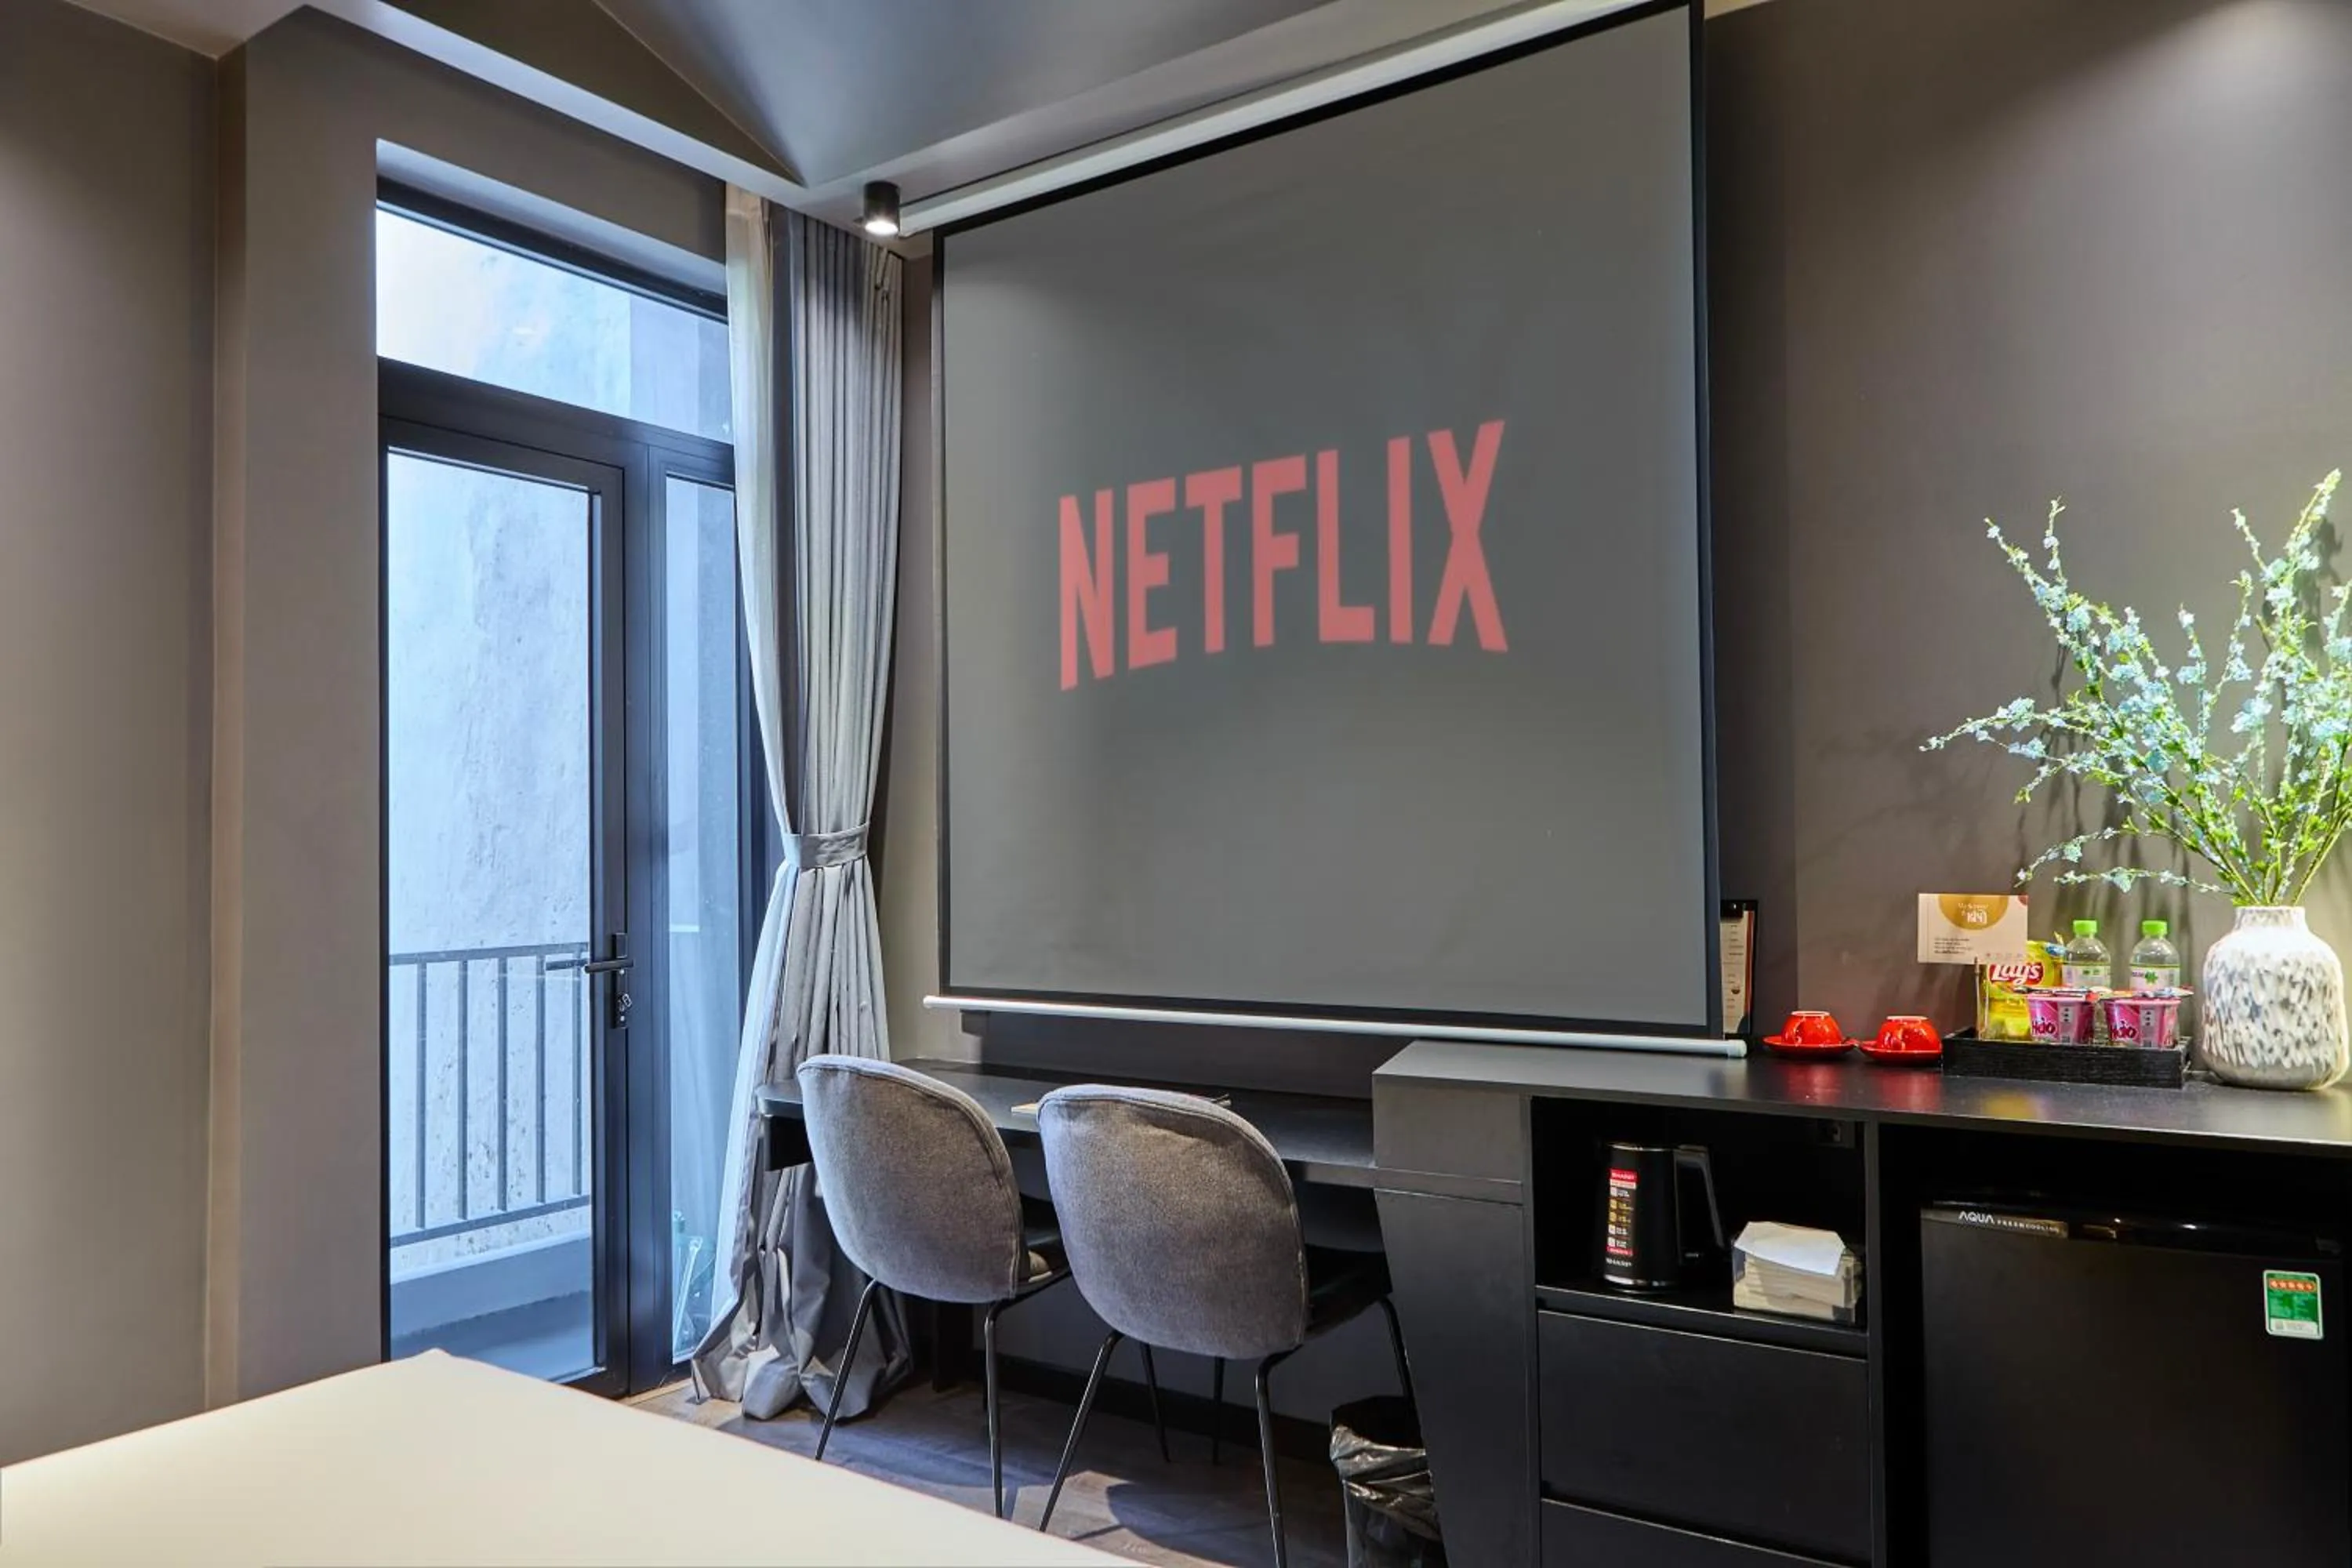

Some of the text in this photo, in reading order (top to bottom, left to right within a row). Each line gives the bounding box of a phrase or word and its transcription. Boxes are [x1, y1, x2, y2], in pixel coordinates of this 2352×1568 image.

[1060, 419, 1508, 691] NETFLIX
[1991, 963, 2042, 985] Lay's
[1959, 1210, 1994, 1224] AQUA
